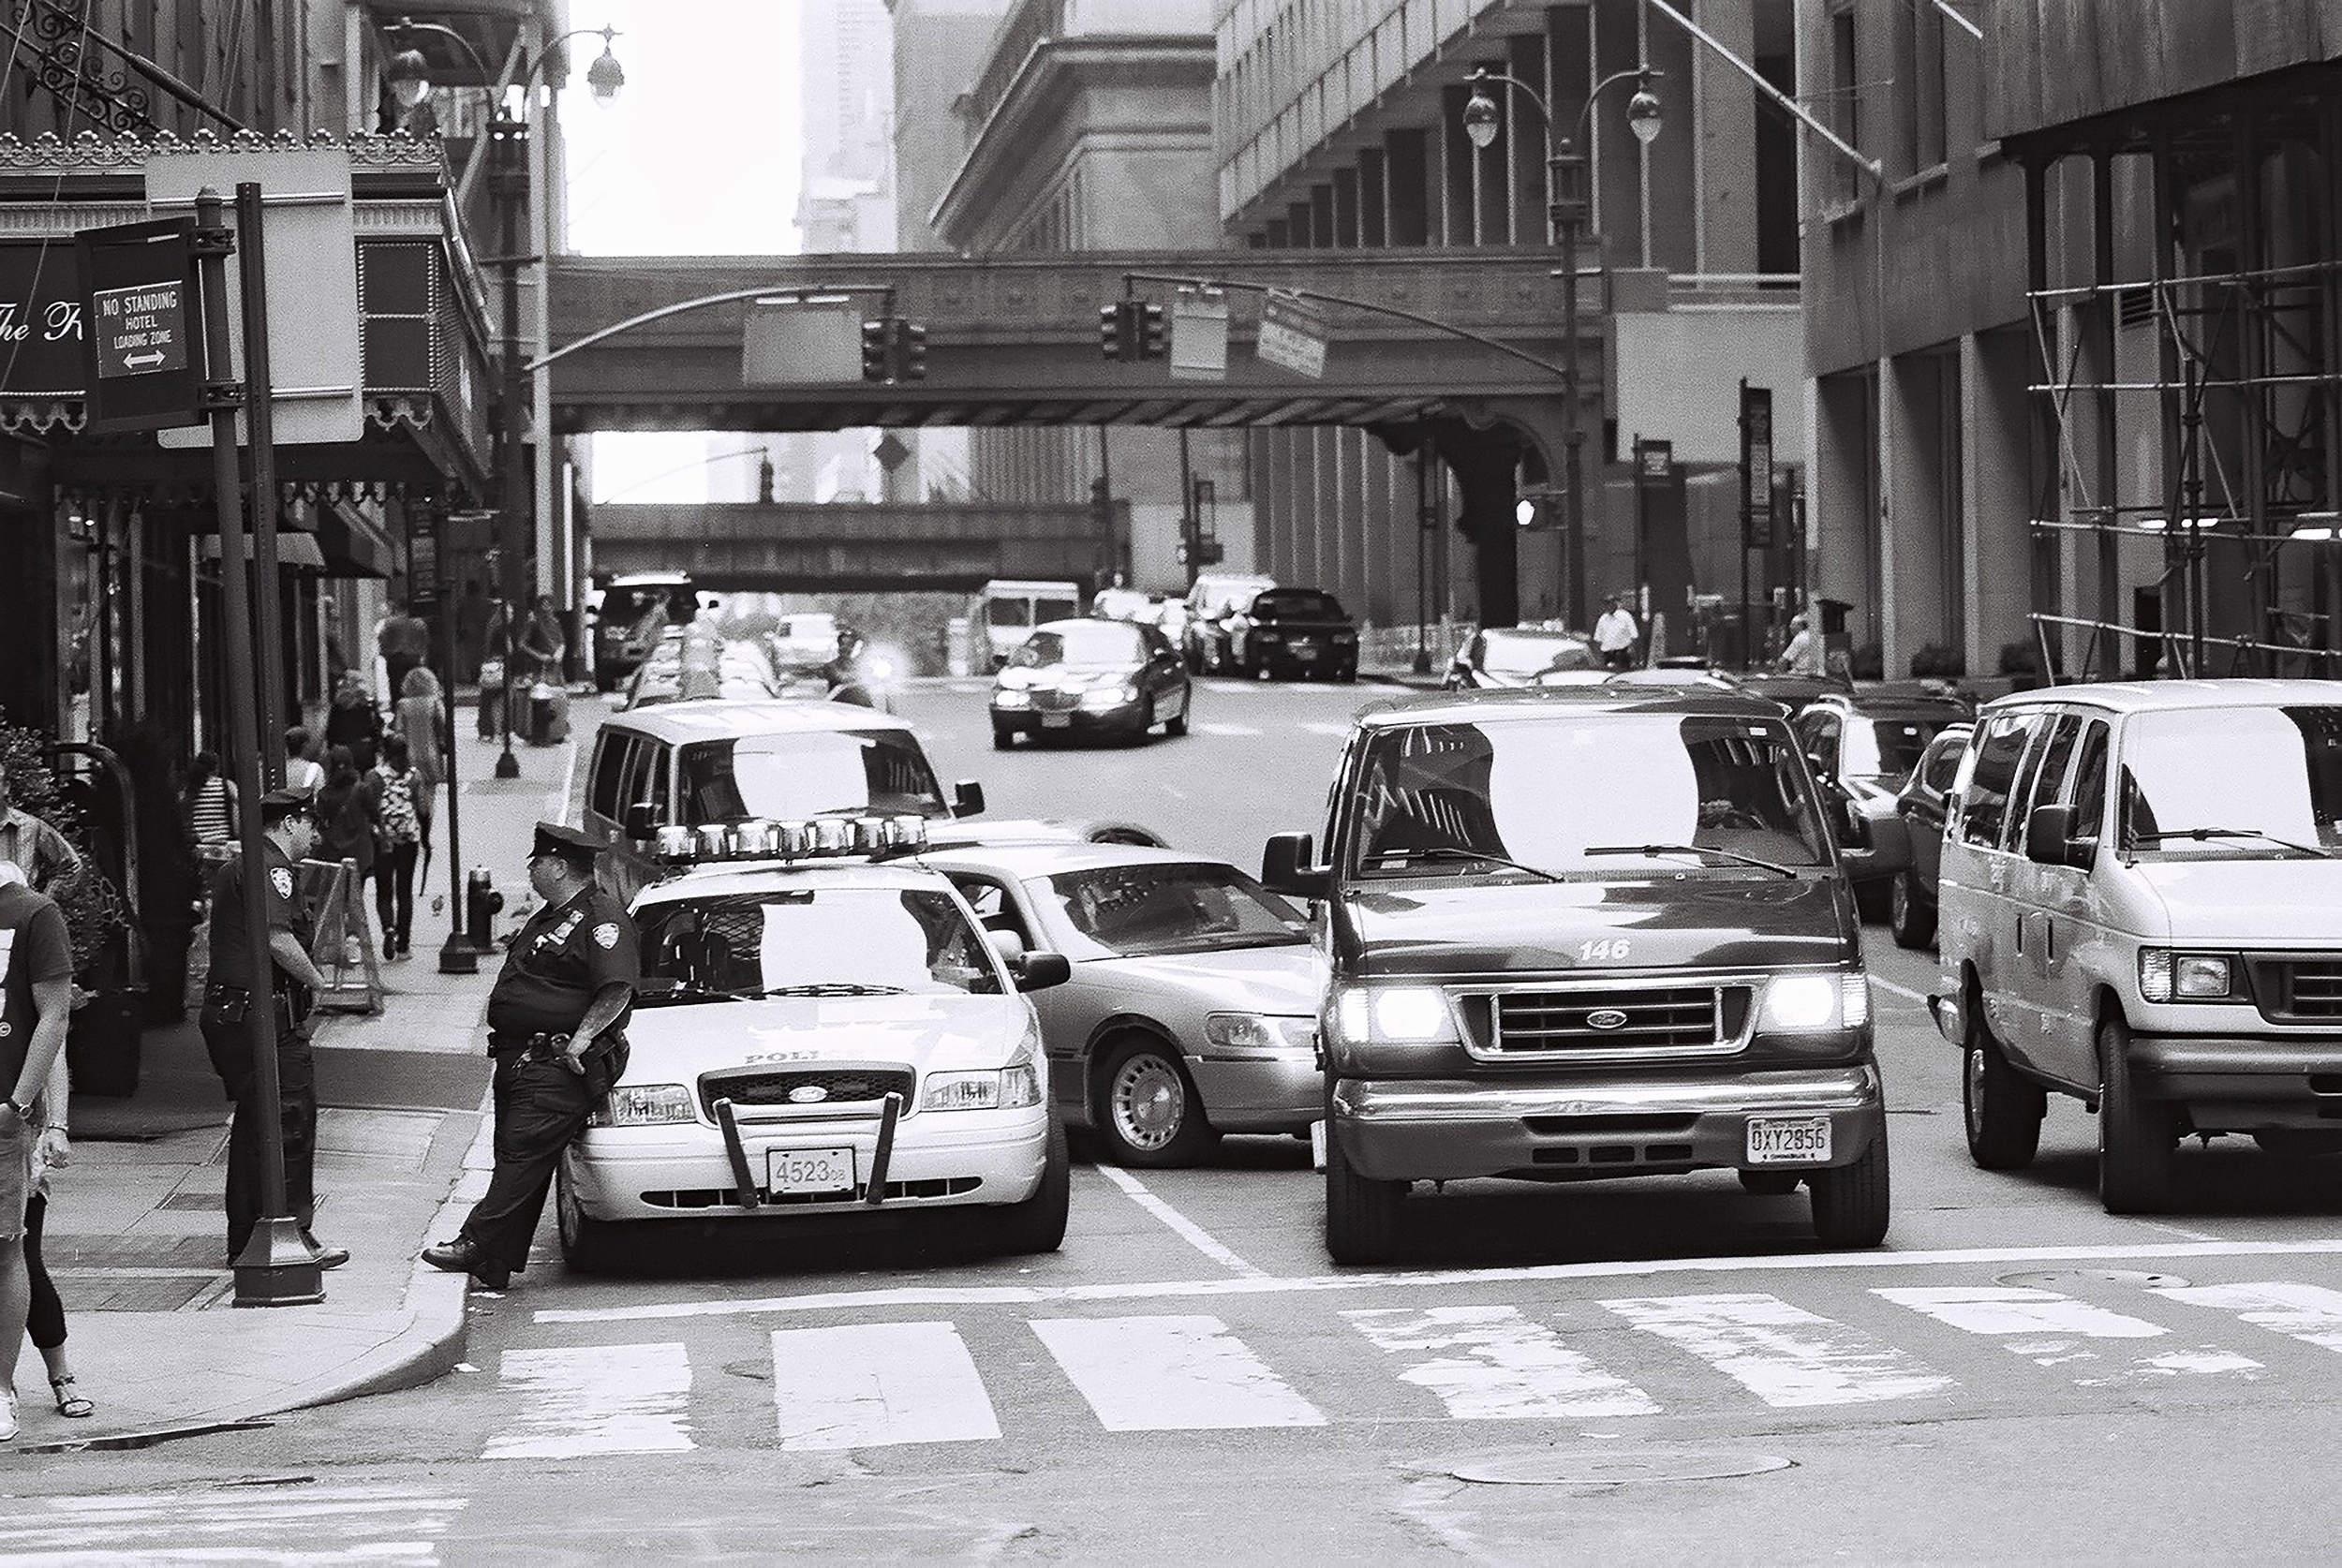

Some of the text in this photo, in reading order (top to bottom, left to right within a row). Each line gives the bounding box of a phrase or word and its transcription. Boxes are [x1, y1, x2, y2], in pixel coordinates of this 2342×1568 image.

[103, 291, 178, 317] NO STANDING
[125, 315, 158, 331] HOTEL
[113, 330, 172, 350] LOADING ZONE
[1579, 939, 1631, 962] 146
